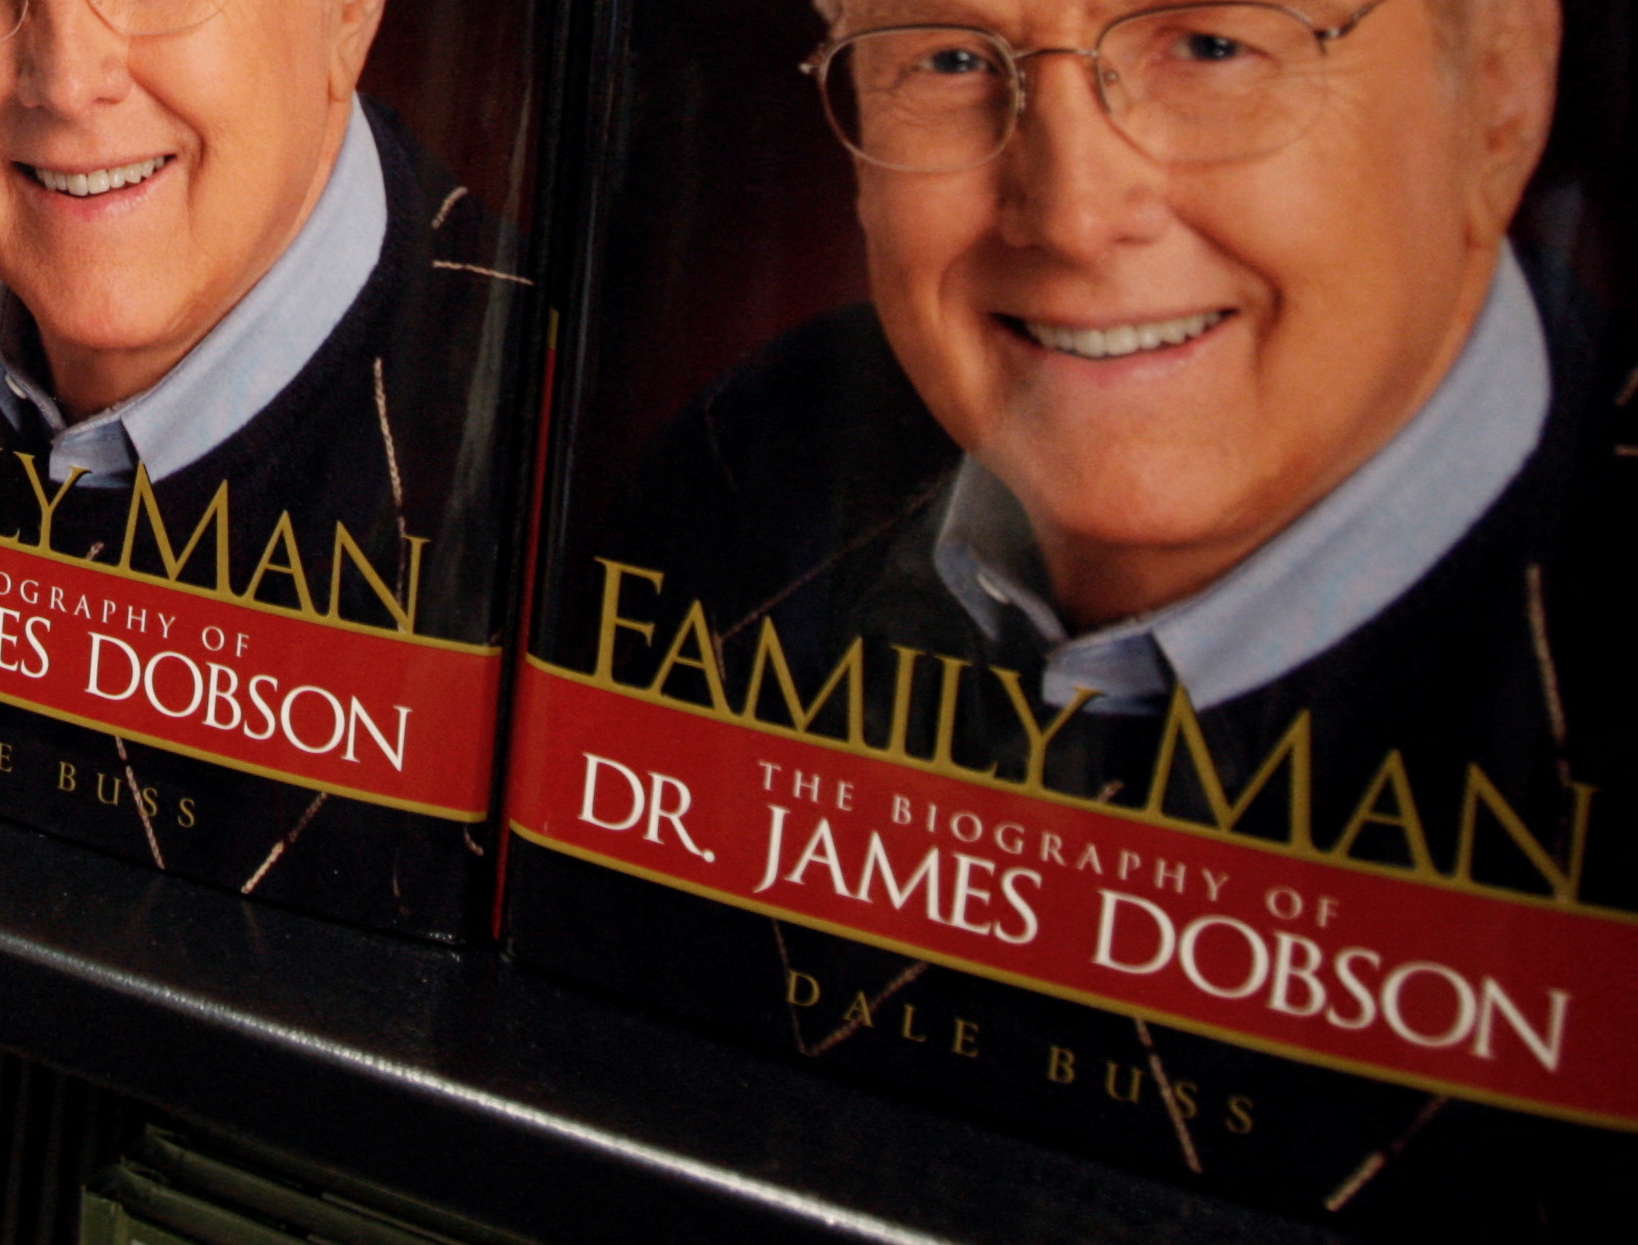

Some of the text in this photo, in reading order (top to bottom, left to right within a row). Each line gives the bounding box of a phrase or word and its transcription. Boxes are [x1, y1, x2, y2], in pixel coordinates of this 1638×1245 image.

[118, 461, 431, 635] MAN
[84, 630, 413, 774] DOBSON
[200, 625, 252, 659] OF
[57, 761, 199, 830] BUSS
[594, 557, 1599, 904] FAMILY MAN
[577, 752, 1571, 1074] DR. JAMES DOBSON
[758, 760, 1341, 929] THE BIOGRAPHY OF
[785, 969, 1257, 1136] DALE BUSS
